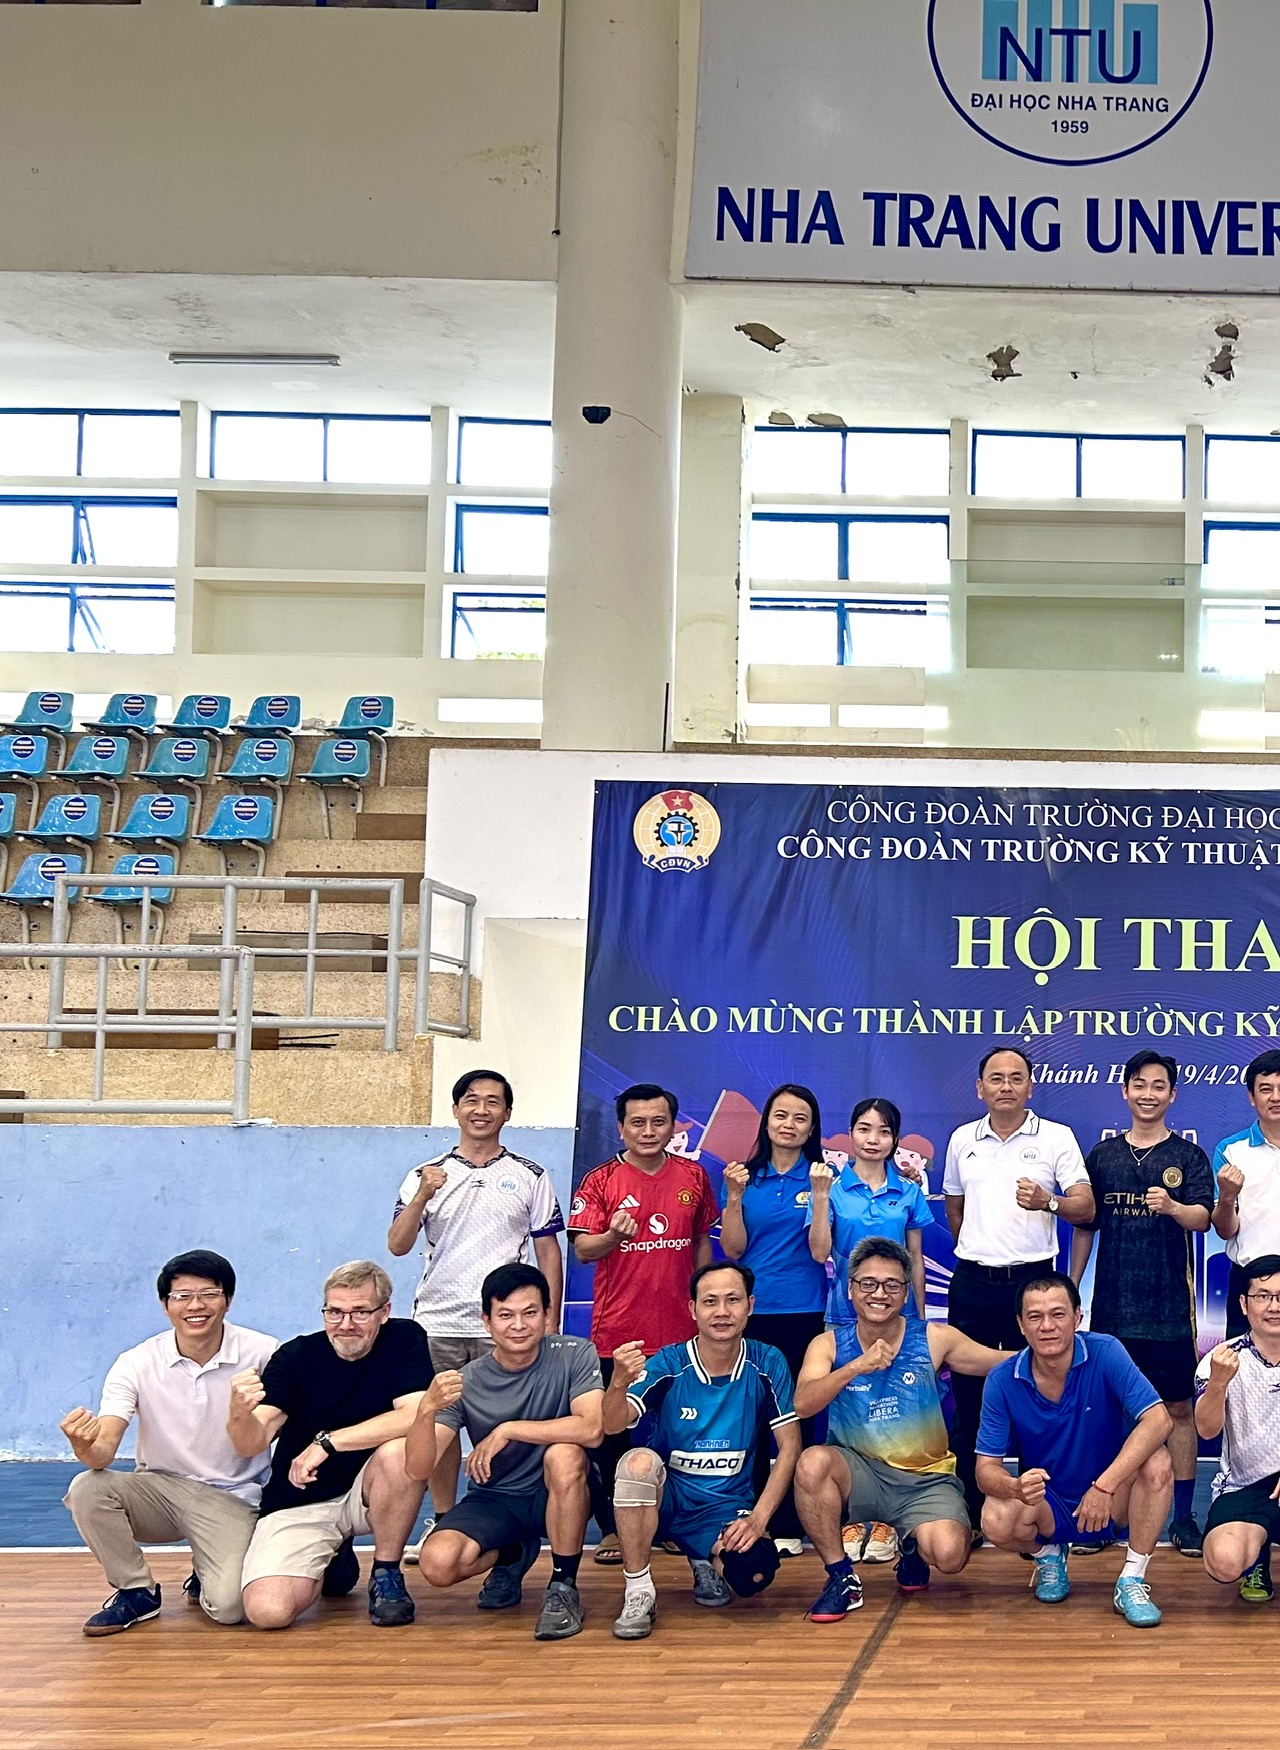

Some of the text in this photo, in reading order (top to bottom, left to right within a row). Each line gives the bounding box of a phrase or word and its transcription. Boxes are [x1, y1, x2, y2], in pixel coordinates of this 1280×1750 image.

[999, 27, 1141, 83] NTU
[970, 93, 1169, 112] ĐẠI HỌC NHA TRANG
[1051, 120, 1089, 133] 1959
[716, 187, 845, 246] NHA
[862, 191, 1061, 252] TRANG
[827, 795, 917, 824] CÔNG
[924, 795, 1013, 826] ĐOÀN
[1022, 798, 1154, 829] TRƯỜNG
[1161, 807, 1216, 833] ĐẠI
[776, 831, 872, 859] CÔNG
[880, 832, 973, 861] ĐOÀN
[984, 834, 1120, 863] TRƯỜNG
[1128, 837, 1174, 864] KỸ
[660, 858, 691, 869] CĐVN
[950, 907, 1103, 986] HỘI
[608, 997, 718, 1033] CHÀO
[726, 998, 844, 1034] MỪNG
[852, 1000, 984, 1035] THÀNH
[992, 1005, 1064, 1043] LẬP
[1069, 1003, 1226, 1037] TRƯỜNG
[620, 1237, 692, 1253] Snapdragon
[868, 1406, 899, 1418] LIBERA
[677, 1457, 740, 1469] THACO
